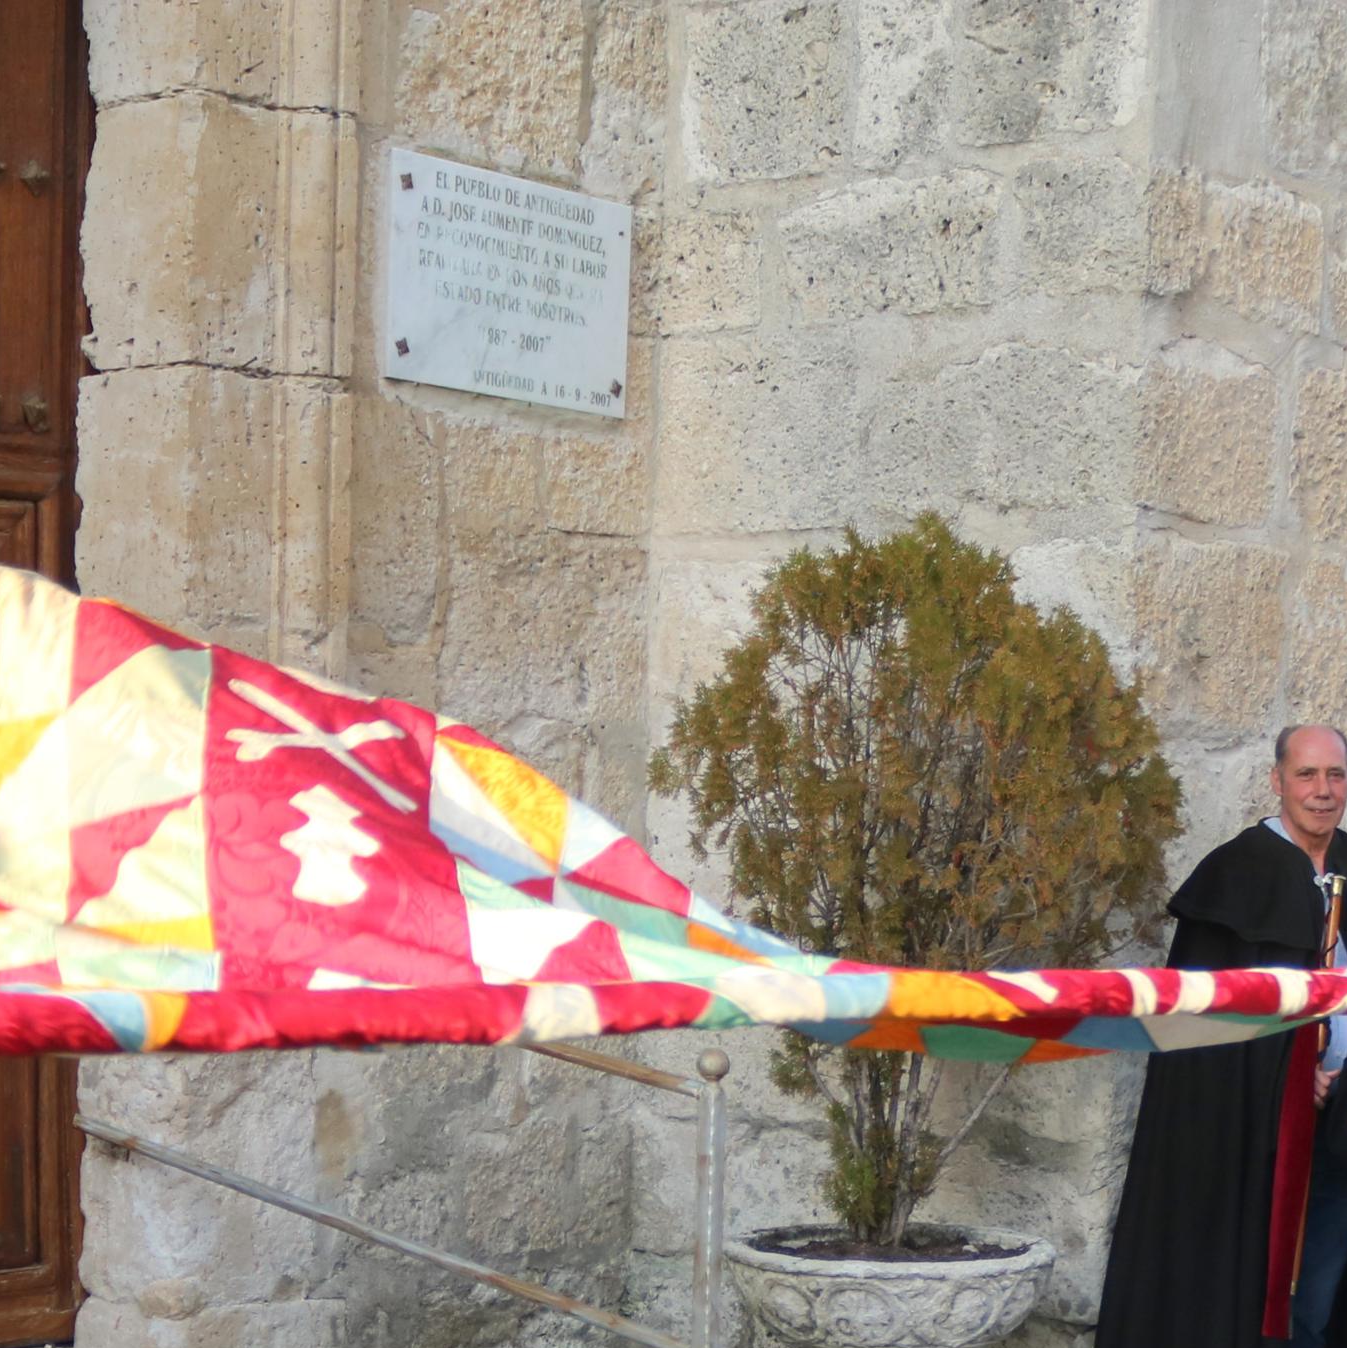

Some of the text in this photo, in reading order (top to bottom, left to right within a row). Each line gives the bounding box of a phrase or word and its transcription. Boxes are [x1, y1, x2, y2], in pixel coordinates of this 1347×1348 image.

[436, 171, 450, 190] EL
[455, 175, 500, 201] PUEBLO
[505, 188, 520, 206] DE
[421, 195, 429, 213] A
[433, 197, 445, 216] D.
[417, 221, 430, 239] EN
[543, 250, 550, 268] A
[554, 254, 569, 270] SU
[572, 257, 608, 279] LABOR
[487, 264, 500, 281] EN
[532, 272, 561, 296] AÑOS
[435, 280, 482, 305] ESTADO
[486, 290, 522, 313] ENTRE
[541, 380, 548, 396] A
